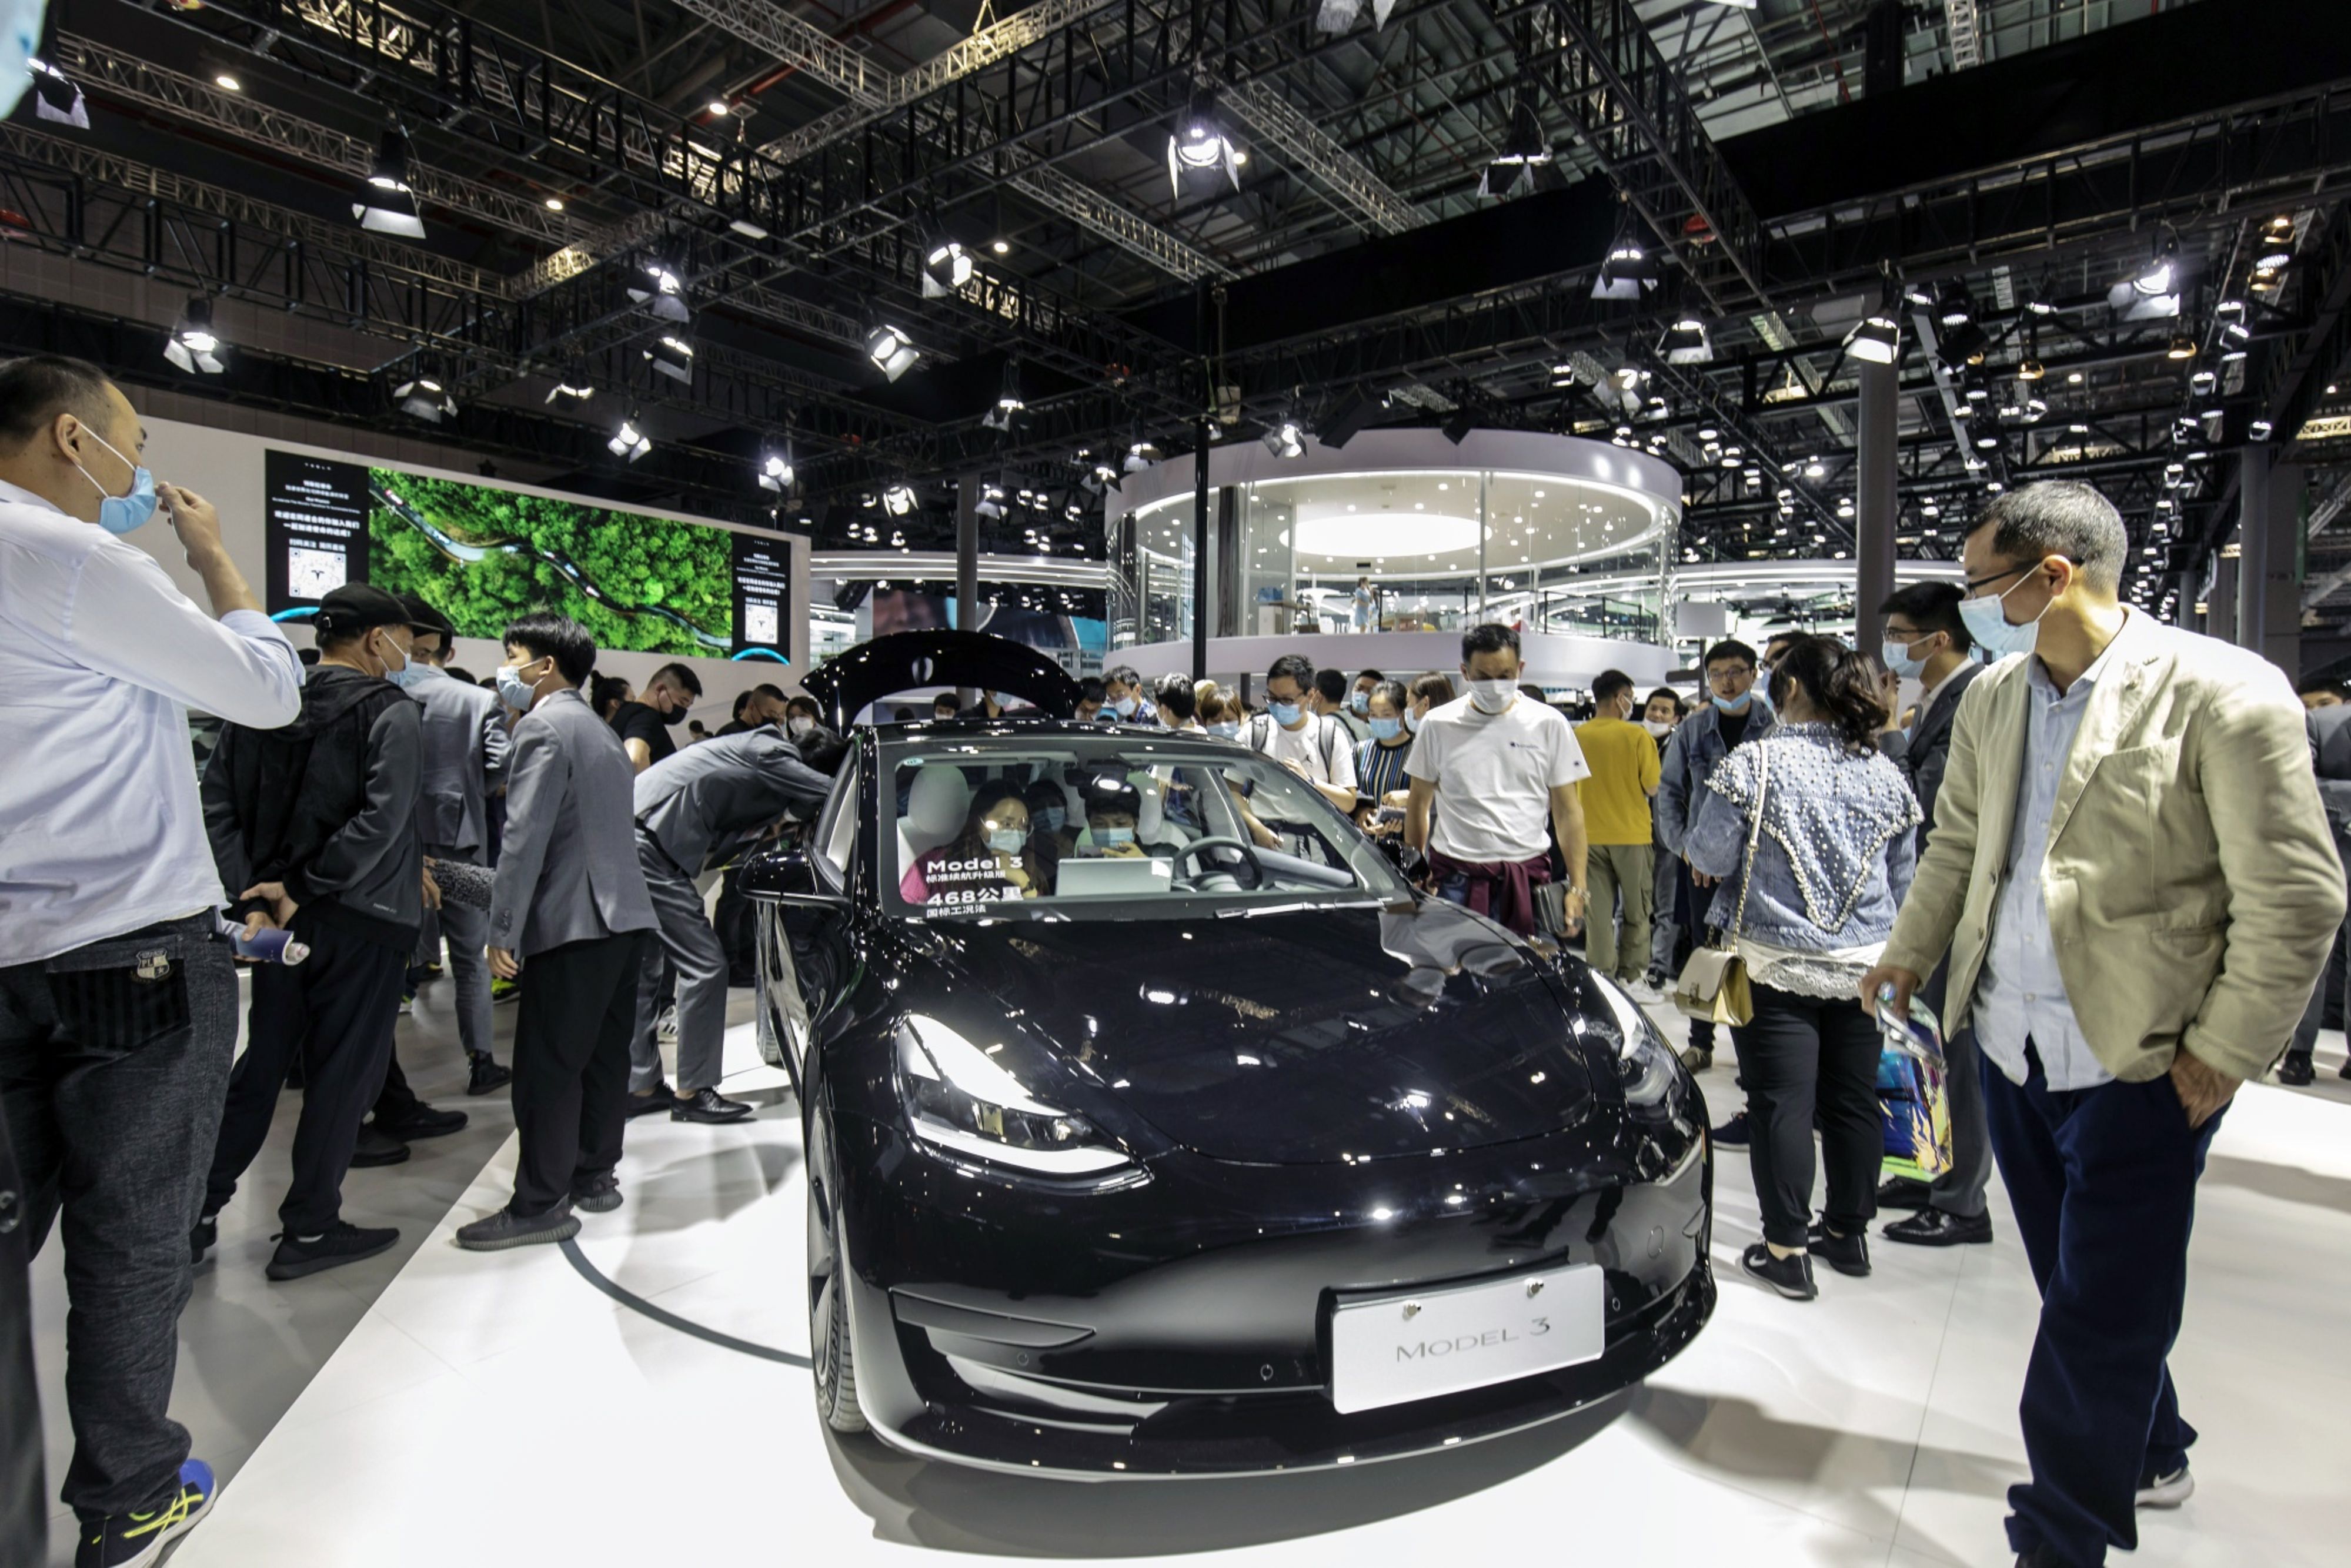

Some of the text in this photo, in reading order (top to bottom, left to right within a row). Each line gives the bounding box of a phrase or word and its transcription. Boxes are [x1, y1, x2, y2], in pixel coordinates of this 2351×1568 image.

[927, 856, 1023, 874] Model 3
[927, 886, 1024, 907] 468公里
[927, 904, 987, 918] 国标工况法
[1397, 1316, 1550, 1362] MODEL 3
